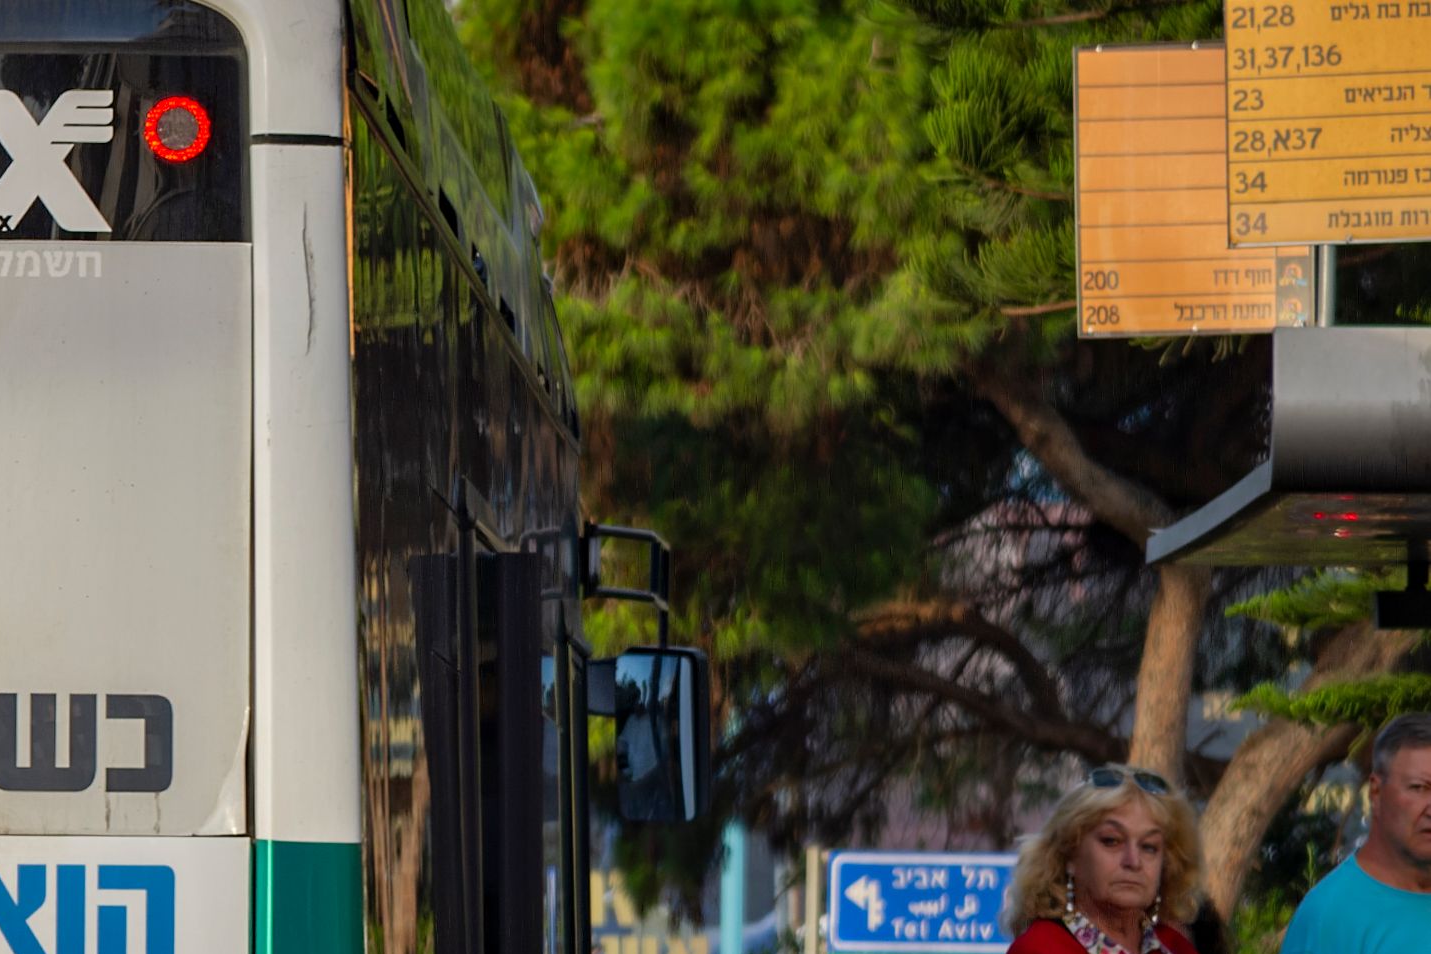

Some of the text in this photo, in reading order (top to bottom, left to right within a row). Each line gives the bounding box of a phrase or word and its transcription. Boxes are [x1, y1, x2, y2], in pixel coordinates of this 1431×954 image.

[1231, 5, 1296, 34] 21,28
[1330, 3, 1370, 22] גלים
[1377, 2, 1401, 19] בת
[1233, 89, 1264, 112] 23
[1344, 85, 1415, 104] הנביאים
[1235, 171, 1267, 194] 34
[1344, 168, 1408, 187] פנורמה
[1235, 213, 1267, 236] 34
[1328, 210, 1393, 229] מוגבלת
[1084, 270, 1119, 291] 200
[1244, 268, 1272, 287] חוף
[1086, 305, 1120, 325] 208
[1174, 302, 1227, 321] הרכבל
[891, 865, 998, 890] תל אביב
[891, 918, 993, 940] Tel Aviv
